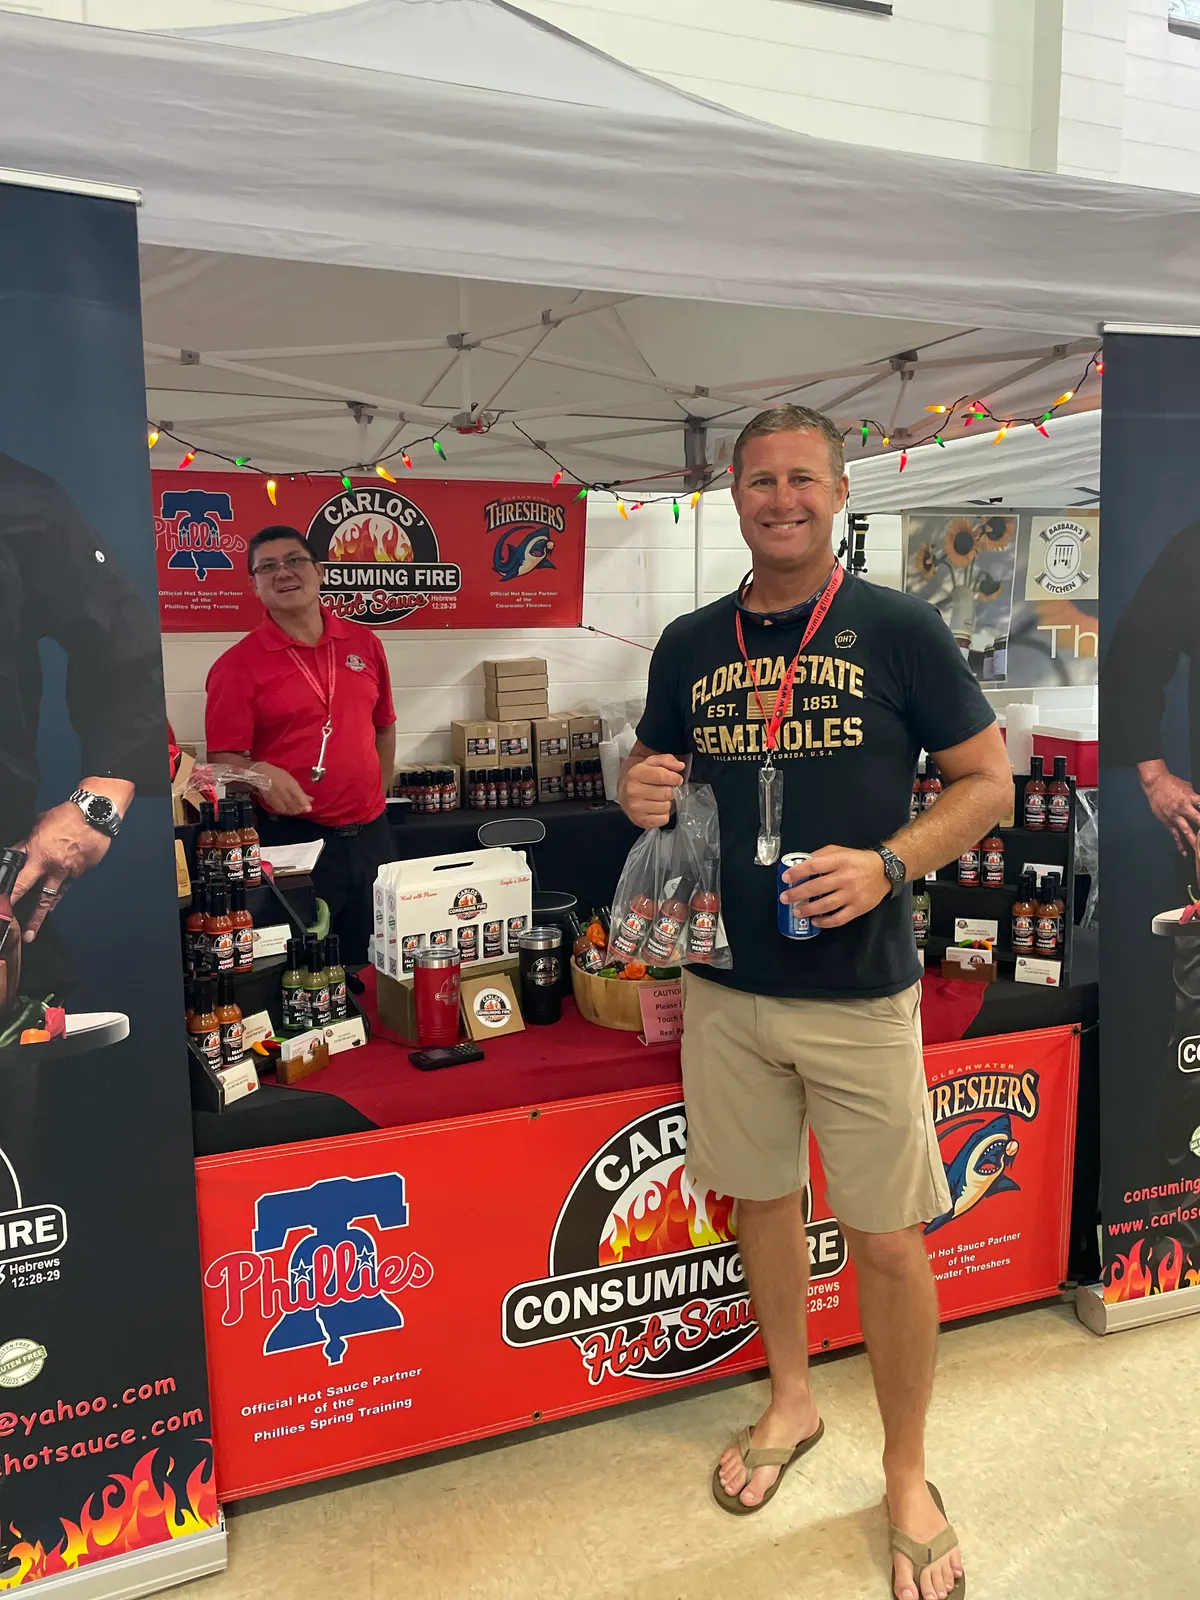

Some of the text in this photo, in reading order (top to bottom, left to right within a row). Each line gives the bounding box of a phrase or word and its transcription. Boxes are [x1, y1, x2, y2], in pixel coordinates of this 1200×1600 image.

[324, 493, 425, 527] CARLOS'
[486, 502, 564, 531] THRESHERS
[153, 515, 248, 553] Phillies
[1048, 522, 1084, 536] BARBARA'S
[323, 569, 456, 586] NSUMING FIRE
[1045, 581, 1076, 594] KITCHEN
[322, 589, 429, 618] Hot Sauce
[691, 655, 788, 714] FLORIDA
[794, 654, 865, 699] STATE
[707, 695, 839, 719] EST. 1851
[693, 716, 864, 754] SEMINOLES
[655, 1003, 678, 1011] Please
[657, 1015, 679, 1024] Touch
[931, 1062, 1015, 1082] CLEARWATER
[1108, 1205, 1200, 1236] www.carlos
[938, 1247, 954, 1258] Hot
[957, 1241, 985, 1253] Sauce
[987, 1232, 1021, 1246] Partner
[9, 1257, 61, 1276] Hebrews
[948, 1254, 976, 1267] of the
[965, 1257, 1011, 1274] Threshers
[11, 1270, 61, 1289] 12:28-29
[204, 1241, 434, 1326] Phillies
[513, 1229, 839, 1331] CONSUMING RE
[806, 1280, 840, 1297] brews
[806, 1296, 840, 1315] :28-29
[583, 1299, 758, 1385] Hot Sau
[22, 1349, 44, 1362] FREE
[241, 1367, 423, 1417] Official Hot Sauce Partner
[314, 1397, 355, 1415] of the
[254, 1397, 413, 1443] Phillies Spring Training
[0, 1406, 204, 1477] hotsauce.com
